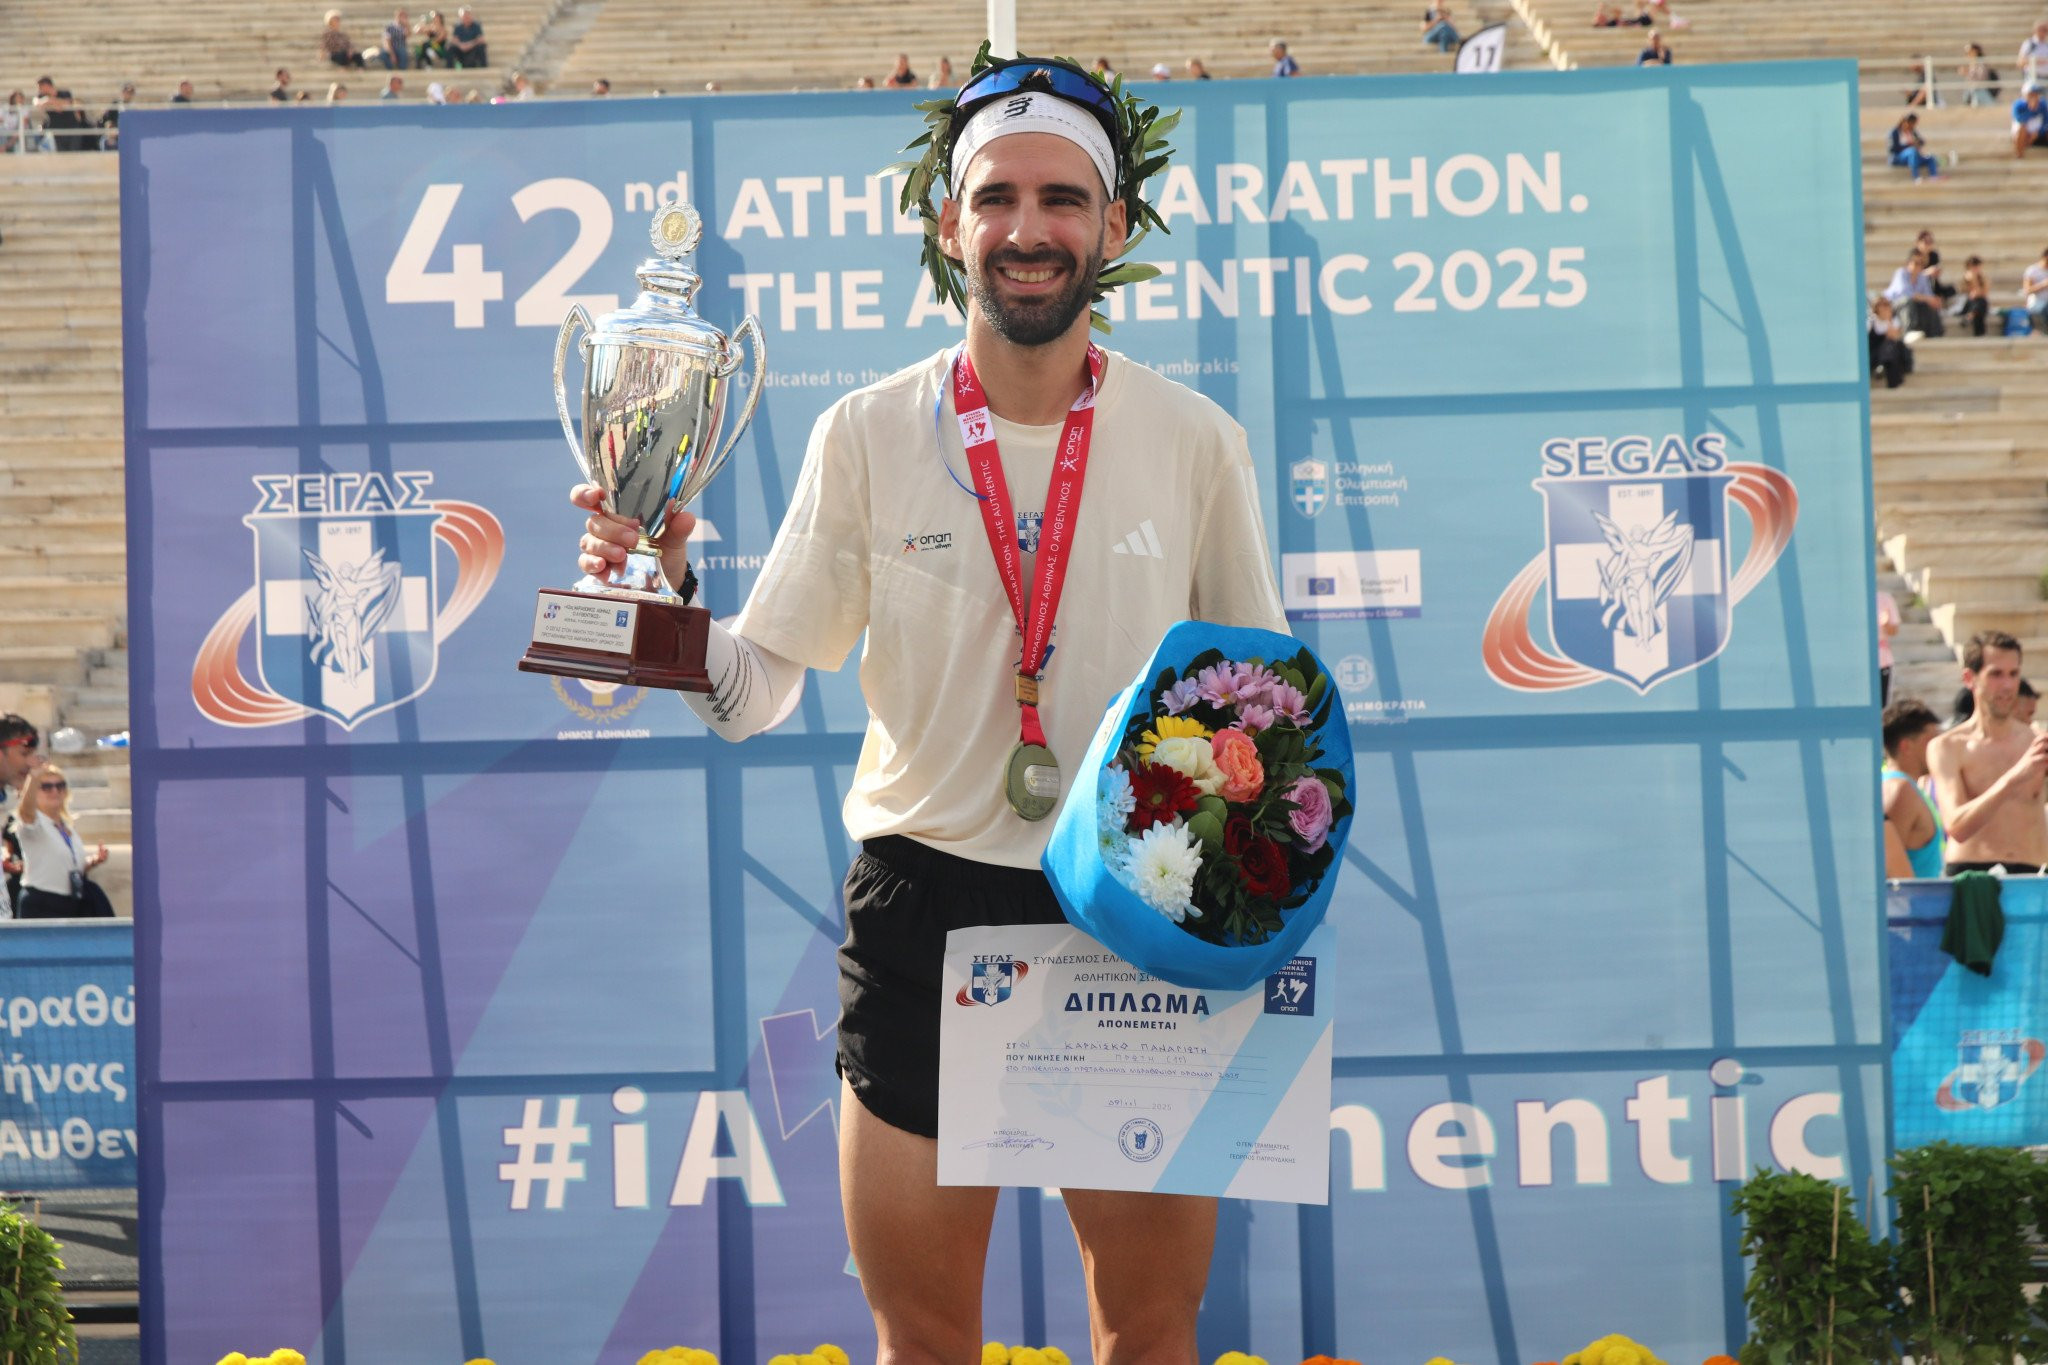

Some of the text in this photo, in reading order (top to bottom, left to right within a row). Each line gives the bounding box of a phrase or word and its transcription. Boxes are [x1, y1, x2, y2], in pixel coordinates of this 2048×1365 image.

[1134, 151, 1589, 228] ARATHON.
[386, 170, 689, 328] 42nd
[729, 270, 886, 332] THE
[1392, 246, 1588, 313] 2025
[738, 369, 831, 388] Ddicated
[836, 371, 855, 385] to
[1541, 432, 1727, 478] SEGAS
[252, 470, 434, 515] ΣΕΓΑΣ
[981, 459, 1002, 517] AUTHENTIC
[1017, 511, 1045, 519] ΣΕΓΑΣ
[1052, 481, 1072, 543] ΑΥΘΕΝΤΙΚΟΣ
[995, 520, 1007, 541] THE
[1051, 543, 1060, 552] Ο
[1029, 602, 1050, 670] ΜΑΡΑΘΩΝΙΟΣ
[1347, 699, 1427, 712] ΔΗΜΟΚΡΑΤΙΑ
[557, 728, 651, 741] ΔΗΜΟΣ ΑΘΗΝΑΙΩΝ
[973, 954, 1013, 964] ΣΕΓΑΣ
[1033, 954, 1100, 965] ΣΥΝΔΕΣΜΟΣ
[1074, 971, 1136, 982] ΑΘΛΗΤΙΚΩΝ
[1064, 992, 1210, 1016] ΔΙΠΛΩΜΑ
[1097, 1018, 1177, 1030] ΑΠΟΝΕΜΕΤΑΙ
[1006, 1054, 1024, 1062] ΠΟΥ
[1027, 1054, 1060, 1062] ΝΙΚΗΣΕ
